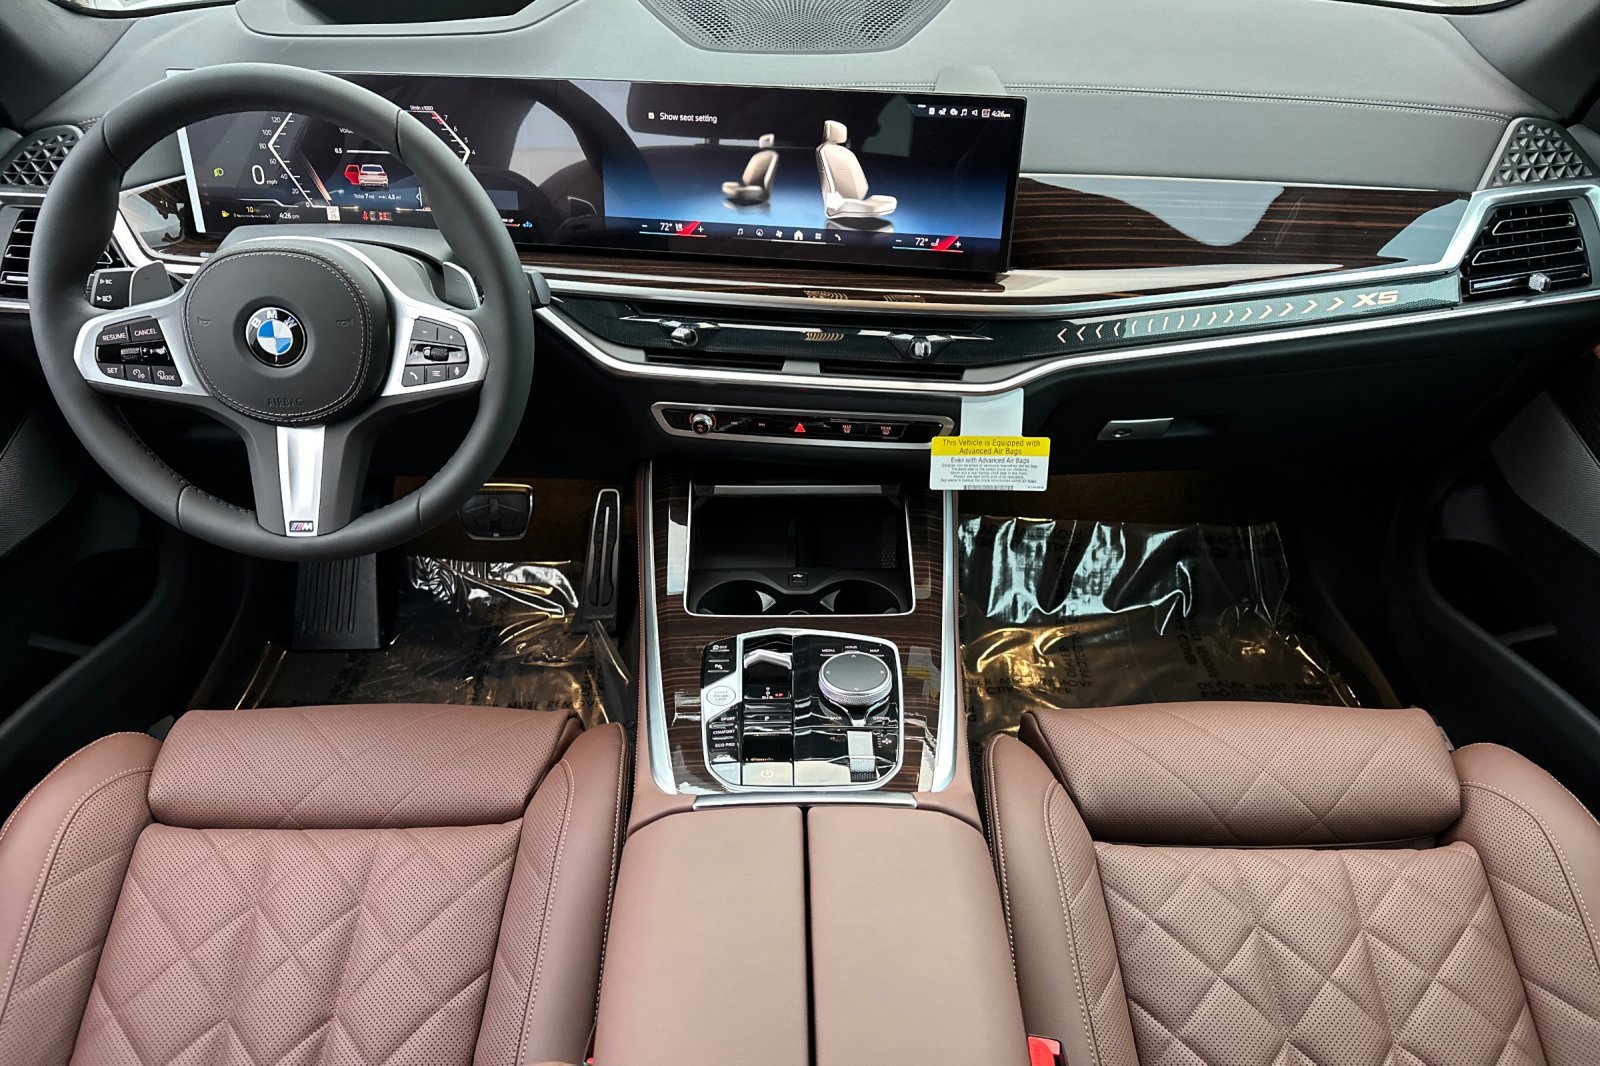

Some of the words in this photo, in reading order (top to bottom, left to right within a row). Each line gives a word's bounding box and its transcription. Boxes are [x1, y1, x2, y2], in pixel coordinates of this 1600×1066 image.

[660, 112, 679, 121] Show
[680, 114, 694, 122] seat
[695, 115, 718, 124] setting
[251, 164, 265, 185] 0
[1352, 290, 1399, 308] X5
[250, 310, 297, 329] BMW
[102, 332, 128, 341] RESUME
[134, 327, 158, 337] CANCEL
[992, 439, 1024, 448] Equipped
[1005, 447, 1022, 456] Bags
